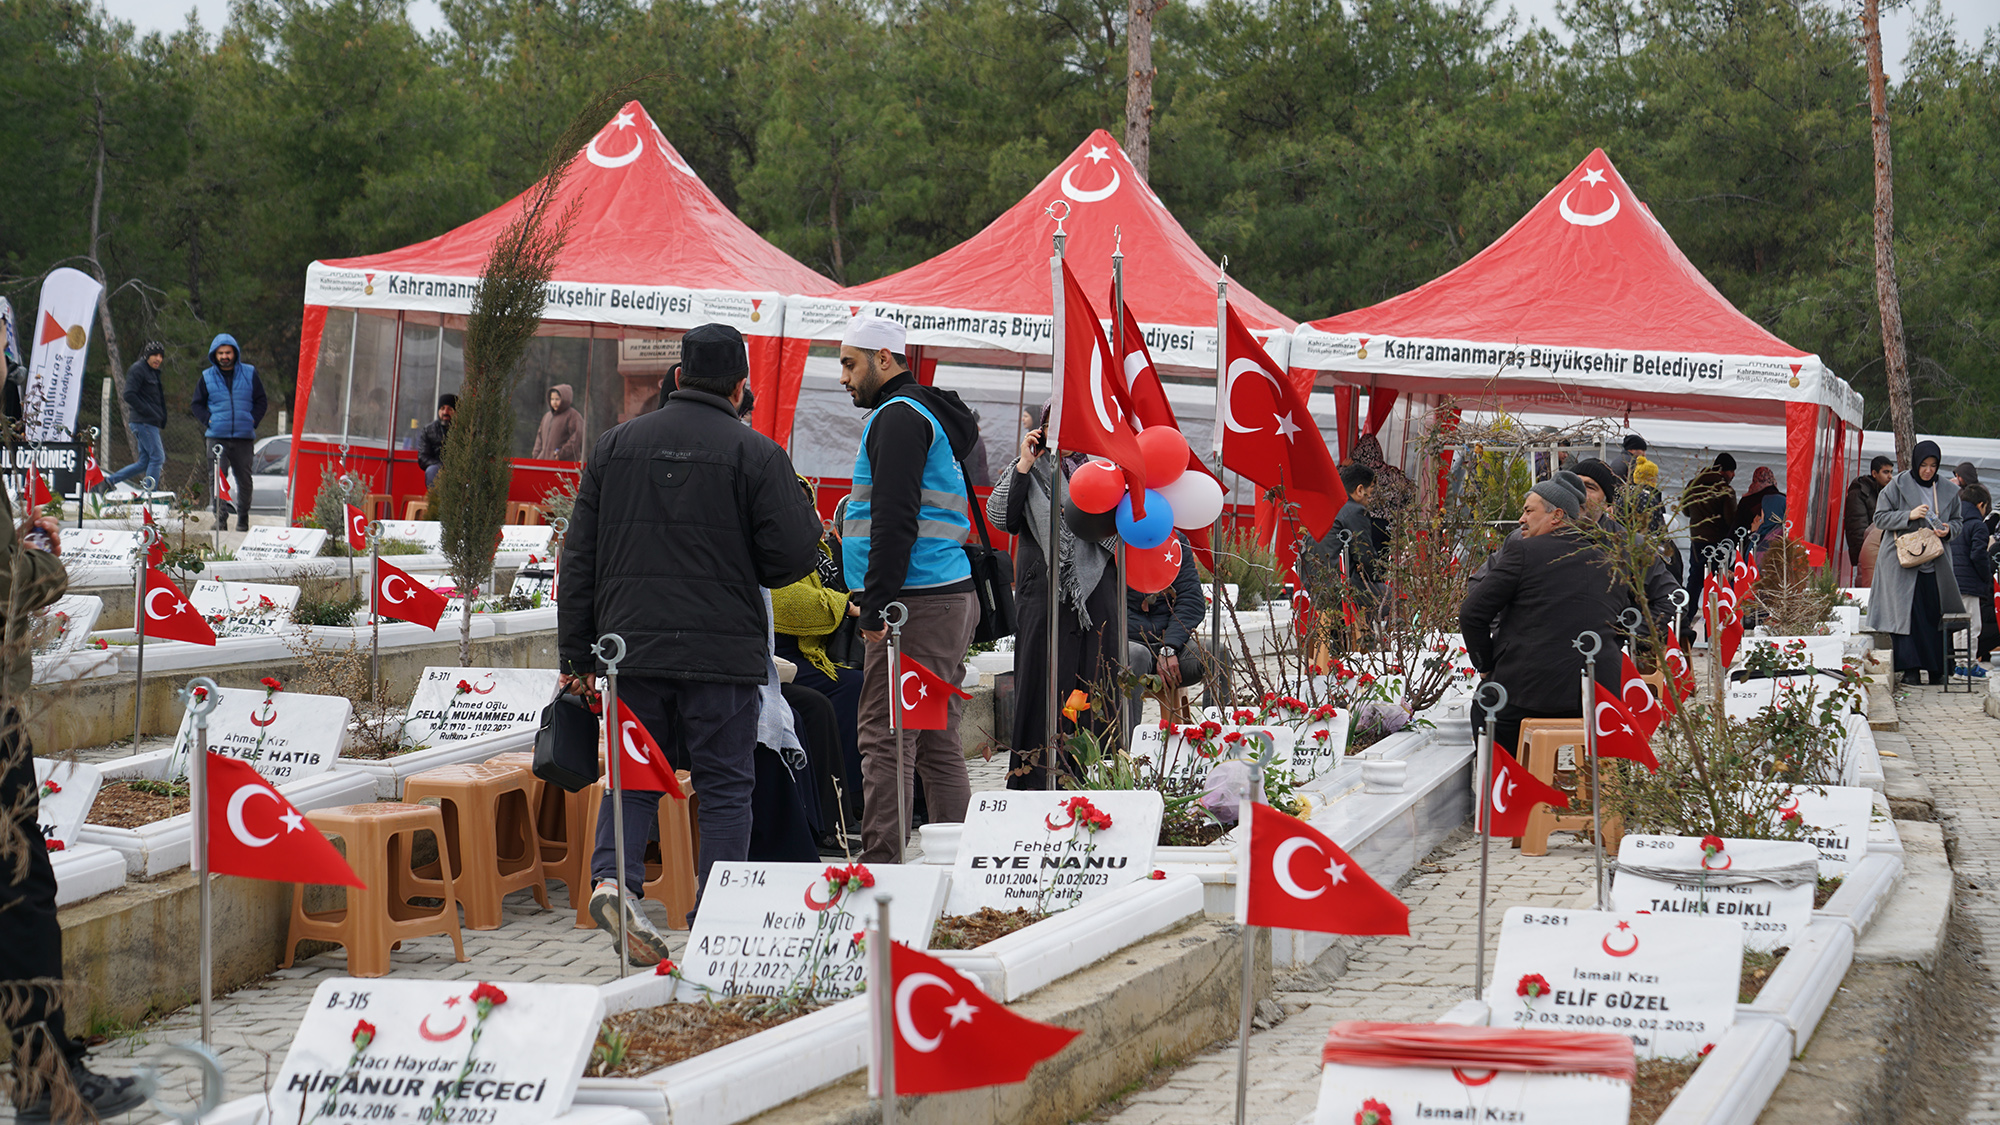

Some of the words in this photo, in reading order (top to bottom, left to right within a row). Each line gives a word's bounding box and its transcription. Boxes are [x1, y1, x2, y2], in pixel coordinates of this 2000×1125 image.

[548, 284, 606, 308] ükşehir
[611, 289, 692, 315] Belediyesi
[1384, 340, 1525, 369] Kahramanmaraş
[1530, 348, 1628, 374] Büyükşehir
[1633, 354, 1723, 382] Belediyesi
[16, 446, 76, 473] ÖZKÖMEÇ
[90, 553, 122, 561] SENDE
[200, 584, 218, 592] B-427
[228, 616, 276, 627] POLAT
[429, 672, 450, 681] B-371
[451, 701, 483, 709] Ahmed
[486, 701, 507, 711] Oğlu
[451, 711, 515, 721] MUHAMMED
[517, 711, 536, 722] ALİ
[1211, 711, 1232, 720] B-11
[267, 736, 289, 747] Kızı
[269, 750, 321, 765] HATİB
[979, 800, 1007, 812] B-313
[1013, 841, 1062, 852] Fehed
[1636, 840, 1675, 850] B-260
[971, 856, 1030, 869] EYE
[1040, 856, 1128, 869] NANU
[719, 870, 766, 888] B-314
[985, 873, 1038, 885] 01.01.2004
[1004, 888, 1045, 900] Ruhuna
[1726, 885, 1753, 894] Kızı
[1651, 897, 1709, 914] TALİHA
[1716, 900, 1771, 916] EDİKLİ
[763, 911, 806, 930] Necib
[1524, 914, 1568, 926] B-261
[1627, 972, 1659, 985] Kızı
[721, 979, 784, 1000] Ruhuna
[325, 992, 372, 1010] B-315
[1555, 988, 1598, 1007] ELİF
[1605, 991, 1669, 1011] GÜZEL
[351, 1054, 388, 1071] Hacı
[394, 1055, 458, 1073] Haydar
[287, 1069, 425, 1098] HİRANUR
[432, 1077, 547, 1103] KEÇECİ
[1485, 1107, 1525, 1123] Kızı
